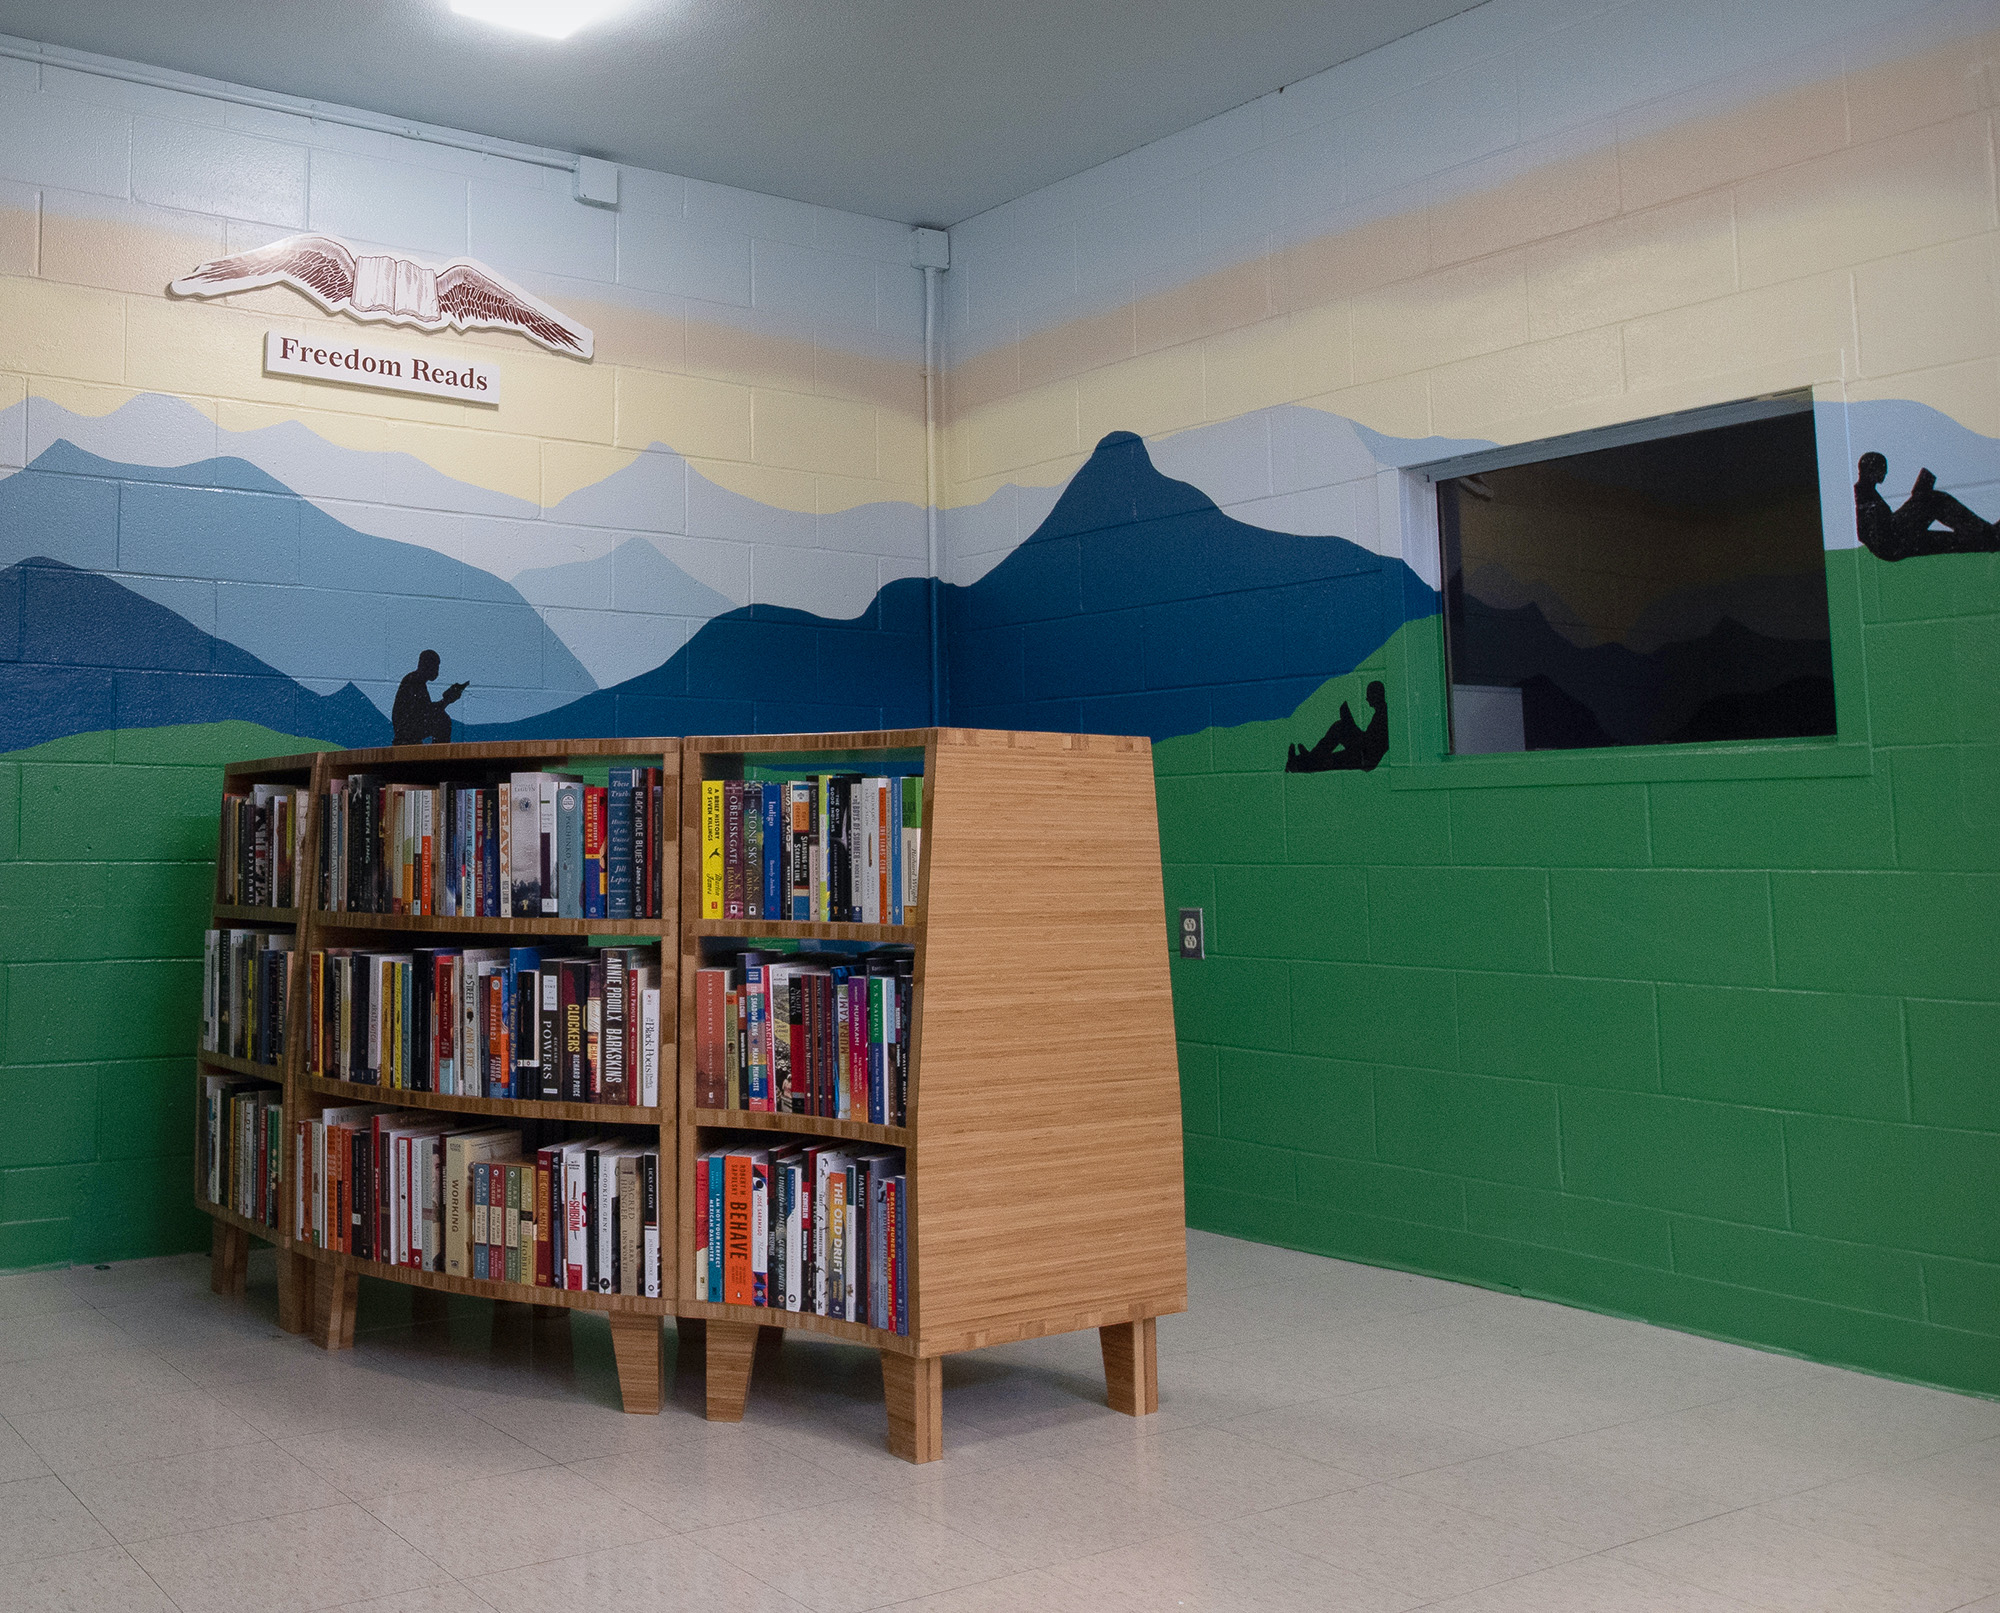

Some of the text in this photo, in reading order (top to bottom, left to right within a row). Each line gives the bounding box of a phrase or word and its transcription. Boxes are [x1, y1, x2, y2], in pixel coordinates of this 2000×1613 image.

[279, 336, 488, 392] Freedom Reads
[500, 788, 509, 876] HEAVY
[634, 792, 643, 864] BLACK HOLE BLUES
[730, 796, 738, 864] OBELISK GATE
[748, 809, 757, 844] STONE
[766, 801, 776, 826] Indigo
[852, 806, 860, 821] BOYS
[614, 865, 626, 874] Jill
[748, 847, 757, 866] SKY
[852, 833, 860, 859] SUMMER
[466, 980, 474, 1006] STREET
[750, 986, 759, 1036] THE SHADOW KING
[568, 1004, 580, 1052] CLOCKERS
[606, 958, 622, 1083] ANNIE PROULX BARKSKINS
[840, 996, 849, 1054] MURAKAMI
[466, 1026, 474, 1068] ANN PETRY
[542, 1020, 552, 1080] POWERS
[645, 1022, 654, 1073] Black Poets
[553, 1157, 558, 1169] WE
[569, 1200, 580, 1231] SHIBUMI
[715, 1198, 720, 1207] AM
[730, 1202, 748, 1260] BEHAVE
[833, 1182, 843, 1275] THE OLD DRIFT
